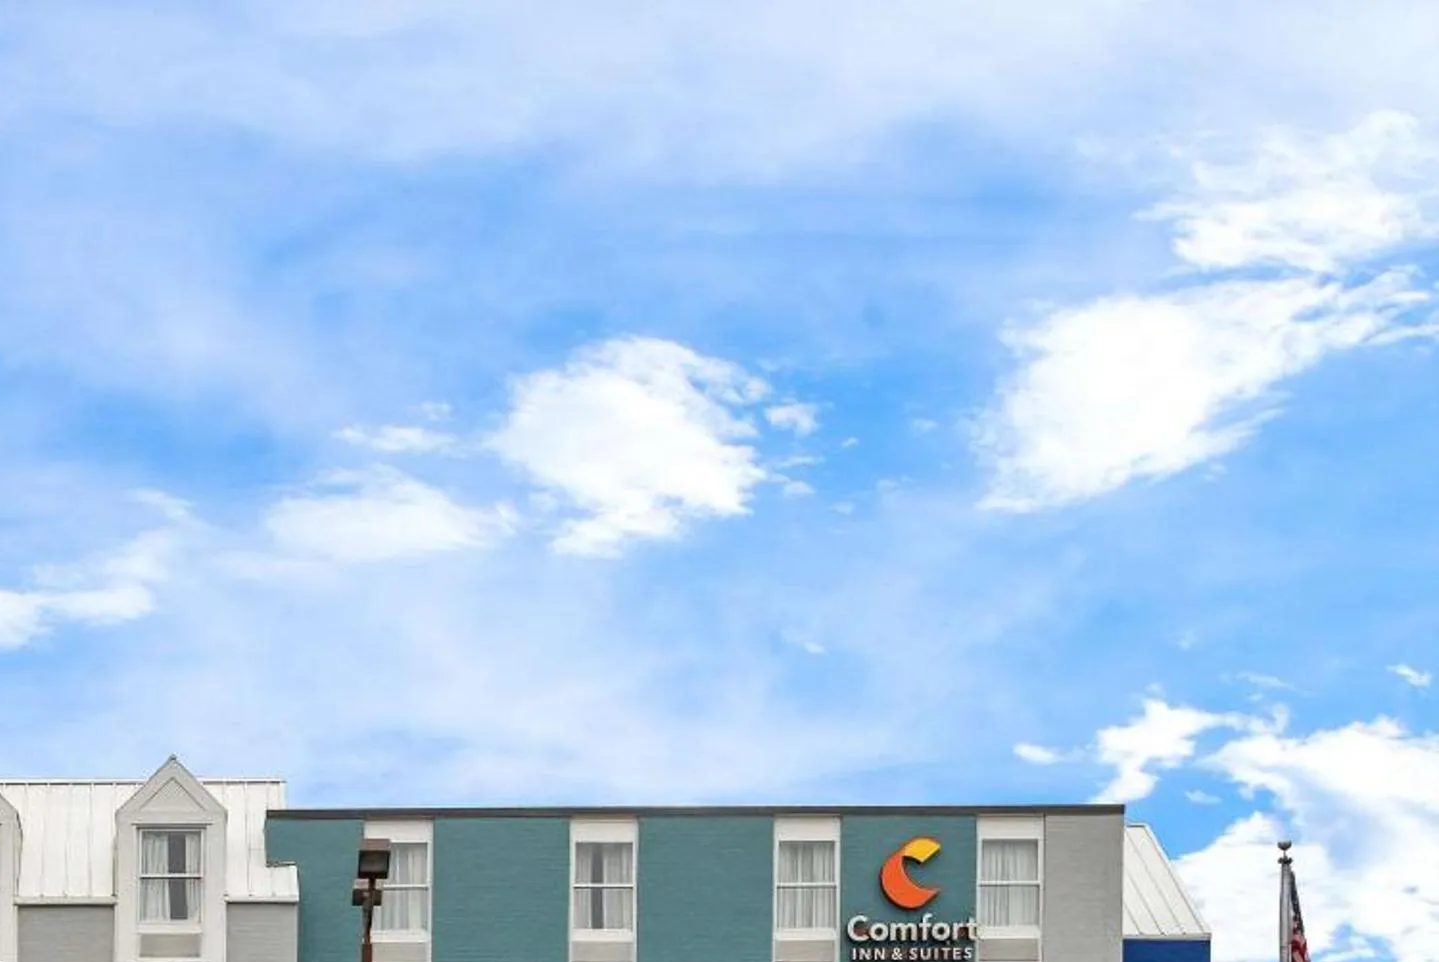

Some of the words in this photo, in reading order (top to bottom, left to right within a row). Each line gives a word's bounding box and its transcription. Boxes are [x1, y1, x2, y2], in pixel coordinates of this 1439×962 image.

[847, 912, 980, 941] Comfort
[852, 948, 885, 961] INN
[891, 947, 903, 961] &
[909, 947, 973, 961] SUITES
